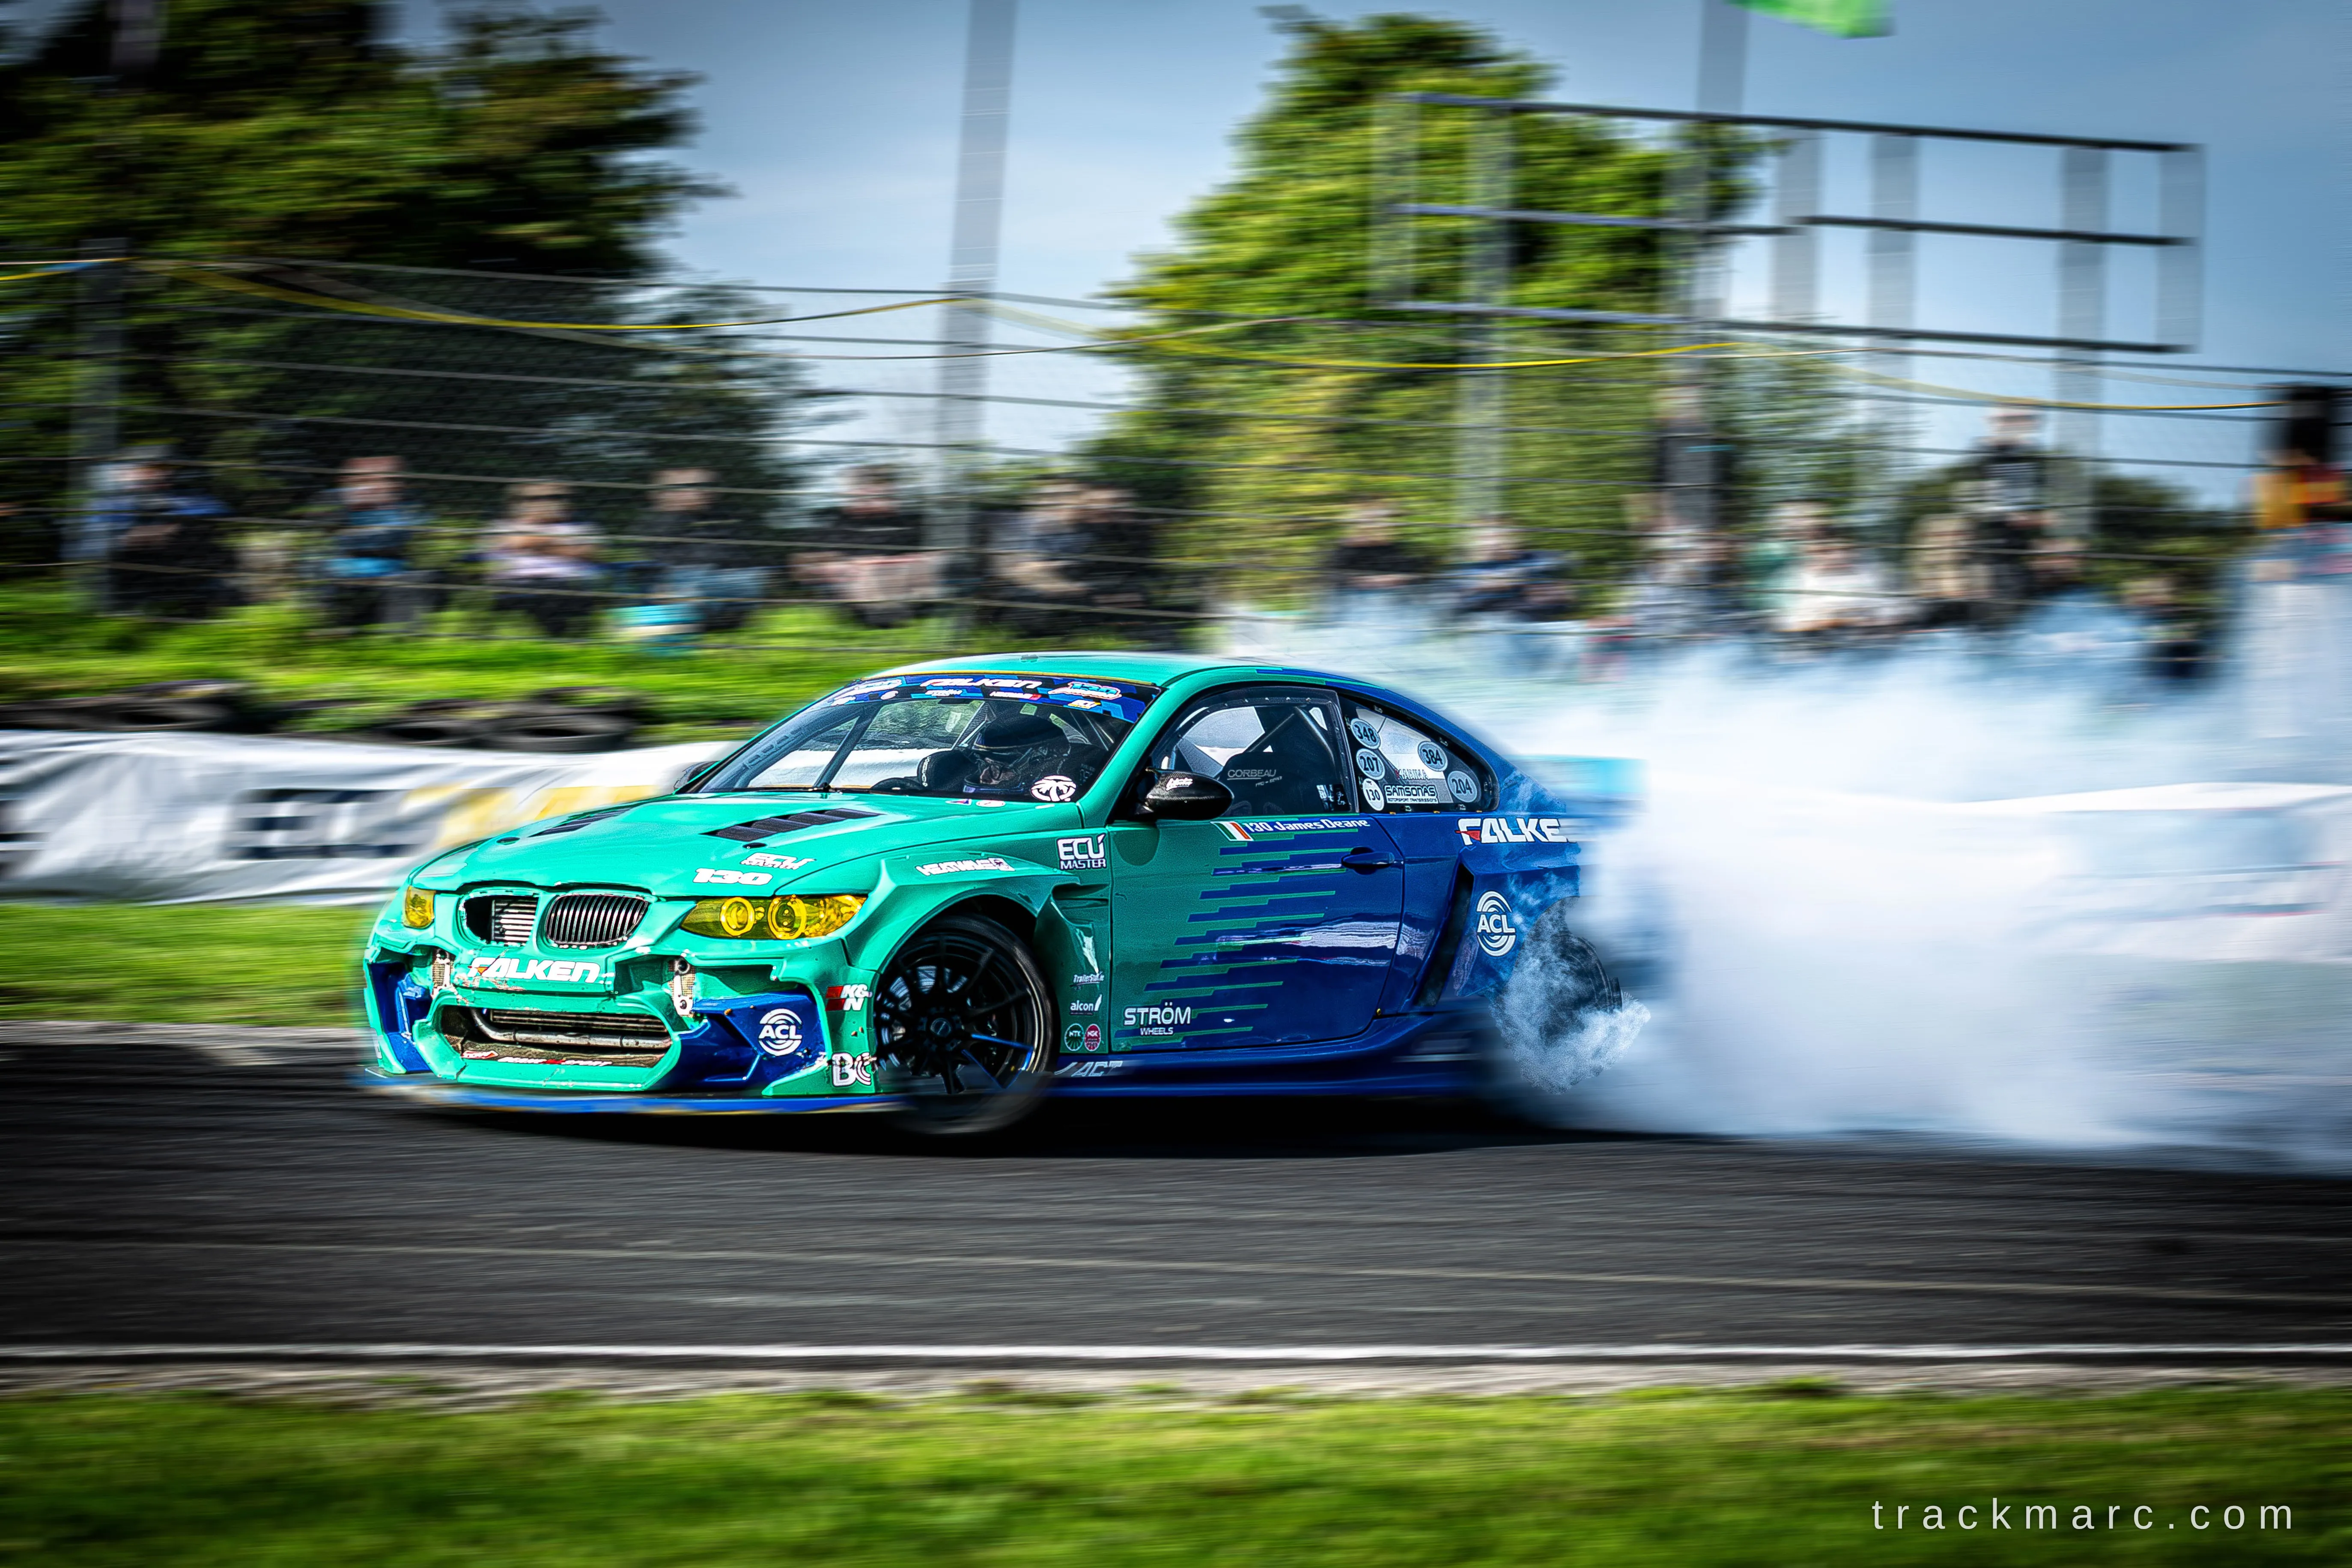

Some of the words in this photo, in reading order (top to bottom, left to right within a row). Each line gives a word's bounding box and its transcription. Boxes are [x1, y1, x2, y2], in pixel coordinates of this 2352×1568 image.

[920, 678, 1043, 689] FALKEN
[1354, 724, 1377, 743] 348
[1359, 755, 1380, 772] 207
[1422, 748, 1443, 765] 384
[1228, 769, 1276, 777] CORBEAU
[1385, 787, 1436, 797] SAMSONAS
[1451, 778, 1473, 794] 204
[1365, 789, 1380, 801] 130
[1242, 822, 1274, 832] 130
[1274, 821, 1324, 831] James
[1320, 819, 1370, 829] Deane
[1458, 817, 1577, 846] FALKE
[1057, 834, 1105, 860] ECU
[1060, 859, 1106, 870] MASTER
[692, 867, 773, 885] 130
[1476, 914, 1516, 933] ACL
[467, 956, 601, 984] FALKEN
[1070, 1000, 1094, 1011] alcon
[1124, 1002, 1191, 1025] STRÖM
[758, 1024, 803, 1039] ACL
[1140, 1027, 1174, 1035] WHEELS
